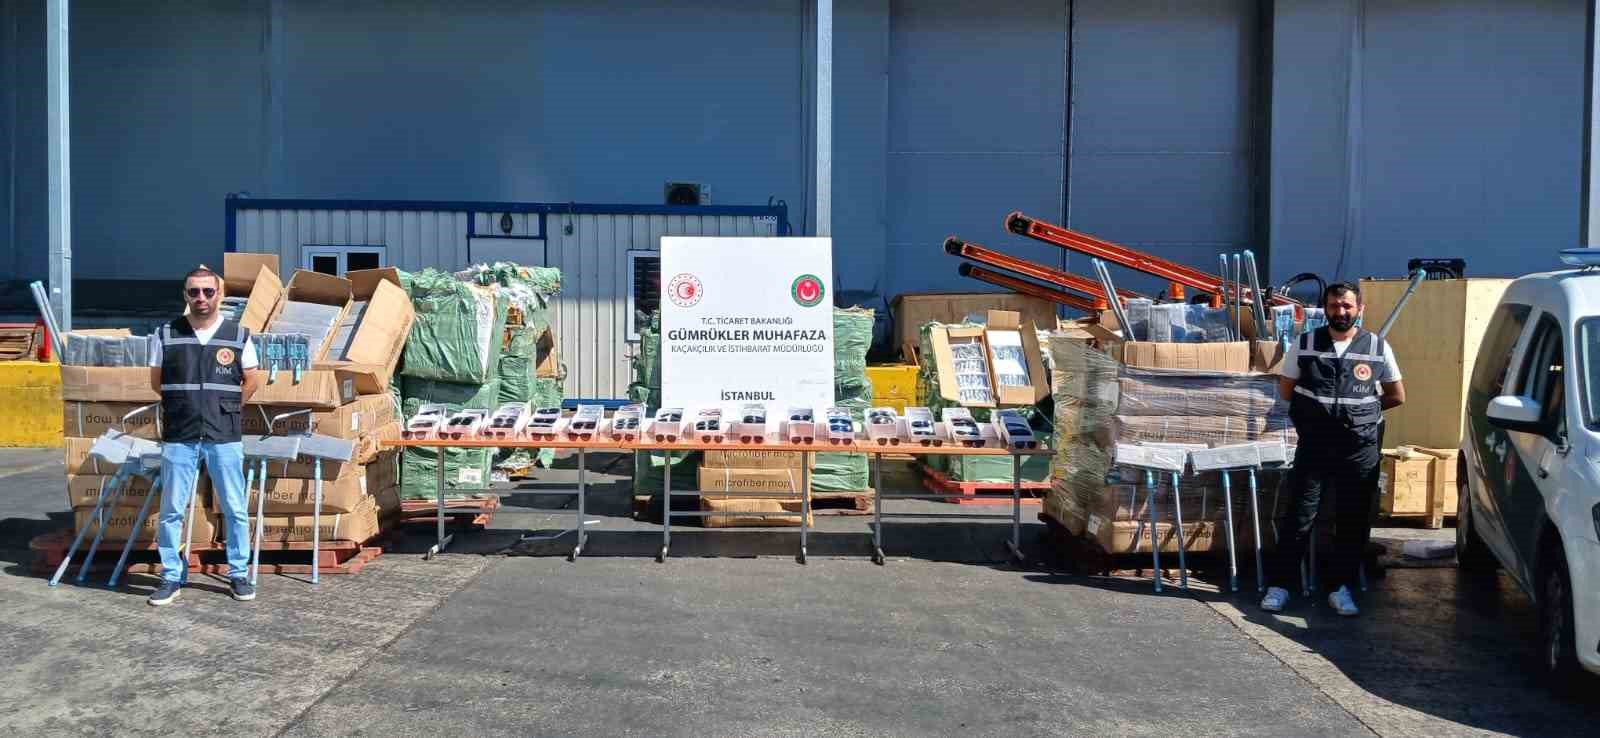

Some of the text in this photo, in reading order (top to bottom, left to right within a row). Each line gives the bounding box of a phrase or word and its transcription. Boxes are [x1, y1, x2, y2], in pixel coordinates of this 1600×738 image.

[701, 316, 793, 325] T.C. TİCARET BAKANLIĞI
[668, 328, 826, 341] GÜMRÜKLER MUHAFAZA
[671, 343, 824, 354] KAÇAKÇILIK VE İSTİHBARAT MÜDÜRLÜĞÜ
[1352, 384, 1370, 393] KİM
[720, 389, 776, 401] İSTANBUL
[714, 478, 791, 489] microfiber mop
